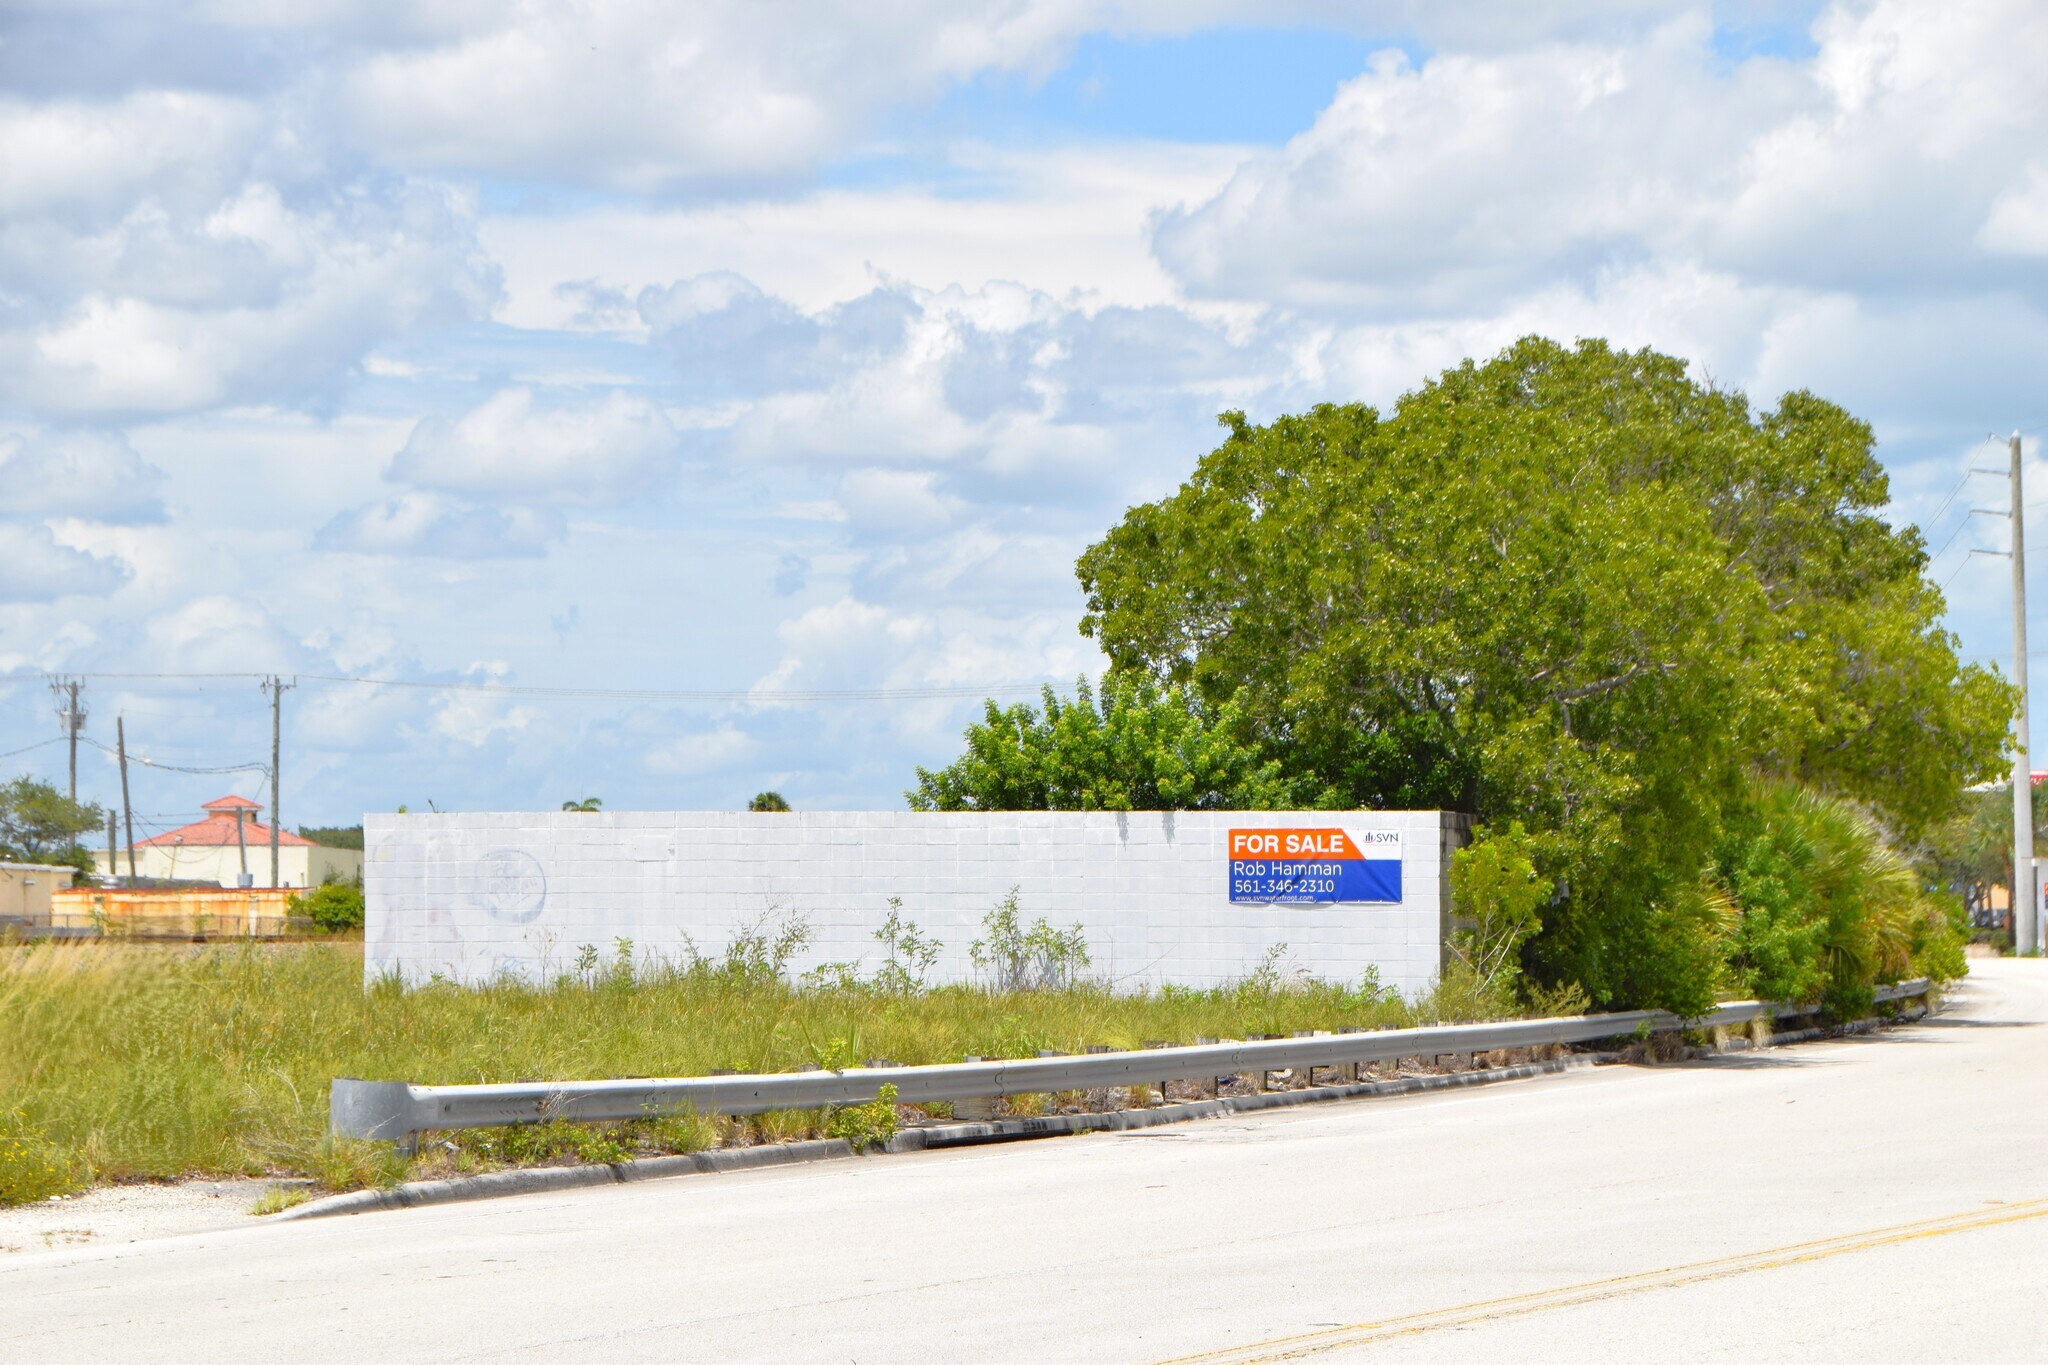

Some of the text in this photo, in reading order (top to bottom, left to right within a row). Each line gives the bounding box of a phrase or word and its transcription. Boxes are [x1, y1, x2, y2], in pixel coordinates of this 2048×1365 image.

[1234, 835, 1344, 853] FOR SALE
[1376, 833, 1399, 843] SVN
[1234, 862, 1342, 876] Rob Hamman
[1235, 880, 1334, 893] 561-346-2310
